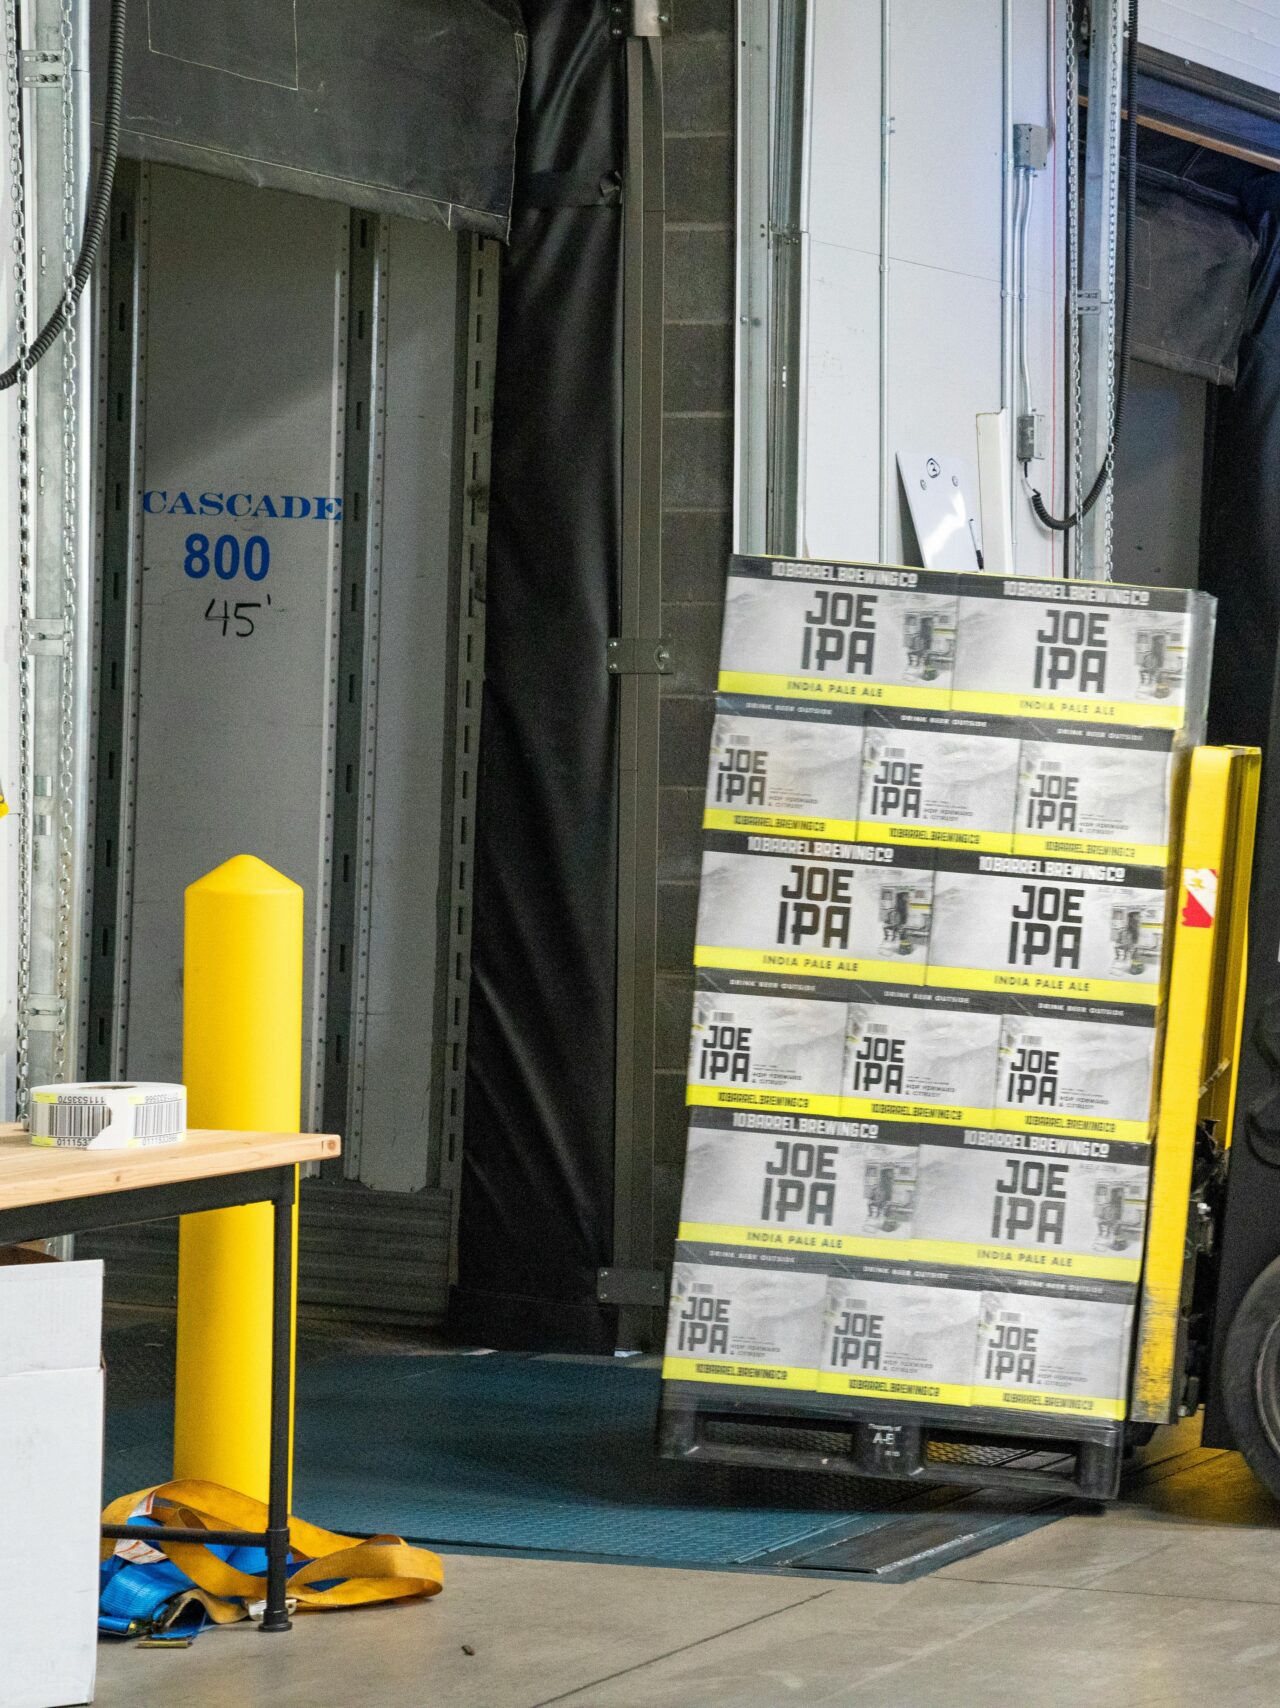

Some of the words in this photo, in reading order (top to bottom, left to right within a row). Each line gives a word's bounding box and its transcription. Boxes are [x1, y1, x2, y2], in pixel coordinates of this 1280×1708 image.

[143, 491, 343, 520] CASCADE
[184, 533, 270, 581] 800
[805, 590, 878, 629] JOE
[1037, 609, 1110, 648] JOE
[801, 627, 875, 675] IPA
[1033, 645, 1107, 693] IPA
[787, 681, 822, 693] INDIA
[828, 684, 856, 696] PALE
[862, 688, 882, 698] ALE
[1020, 699, 1055, 711] INDIA
[1061, 702, 1089, 714] PALE
[1095, 706, 1115, 716] ALE
[719, 748, 768, 774] JOE
[874, 761, 923, 787] JOE
[716, 773, 765, 805] IPA
[871, 786, 920, 818] IPA
[1030, 774, 1079, 800] JOE
[1027, 799, 1076, 831] IPA
[781, 865, 854, 904] JOE
[1012, 885, 1085, 924] JOE
[777, 901, 851, 949] IPA
[1008, 921, 1082, 969] IPA
[763, 955, 798, 967] INDIA
[804, 958, 832, 970] PALE
[838, 962, 858, 972] ALE
[994, 975, 1029, 987] INDIA
[1035, 978, 1063, 990] PALE
[1069, 982, 1089, 992] ALE
[703, 1025, 752, 1051] JOE
[857, 1037, 906, 1063] JOE
[700, 1050, 749, 1082] IPA
[1011, 1048, 1060, 1074] JOE
[854, 1062, 903, 1094] IPA
[1007, 1073, 1056, 1105] IPA
[57, 1138, 93, 1147] 011153
[766, 1141, 839, 1180] JOE
[996, 1160, 1069, 1199] JOE
[762, 1177, 836, 1225] IPA
[991, 1196, 1065, 1244] IPA
[747, 1231, 782, 1243] INDIA
[788, 1234, 816, 1246] PALE
[822, 1239, 842, 1249] ALE
[977, 1249, 1012, 1261] INDIA
[1018, 1253, 1046, 1265] PALE
[1052, 1257, 1072, 1267] ALE
[682, 1296, 731, 1322] JOE
[835, 1312, 884, 1338] JOE
[678, 1321, 727, 1353] IPA
[831, 1337, 880, 1369] IPA
[989, 1325, 1038, 1351] JOE
[986, 1351, 1035, 1383] IPA
